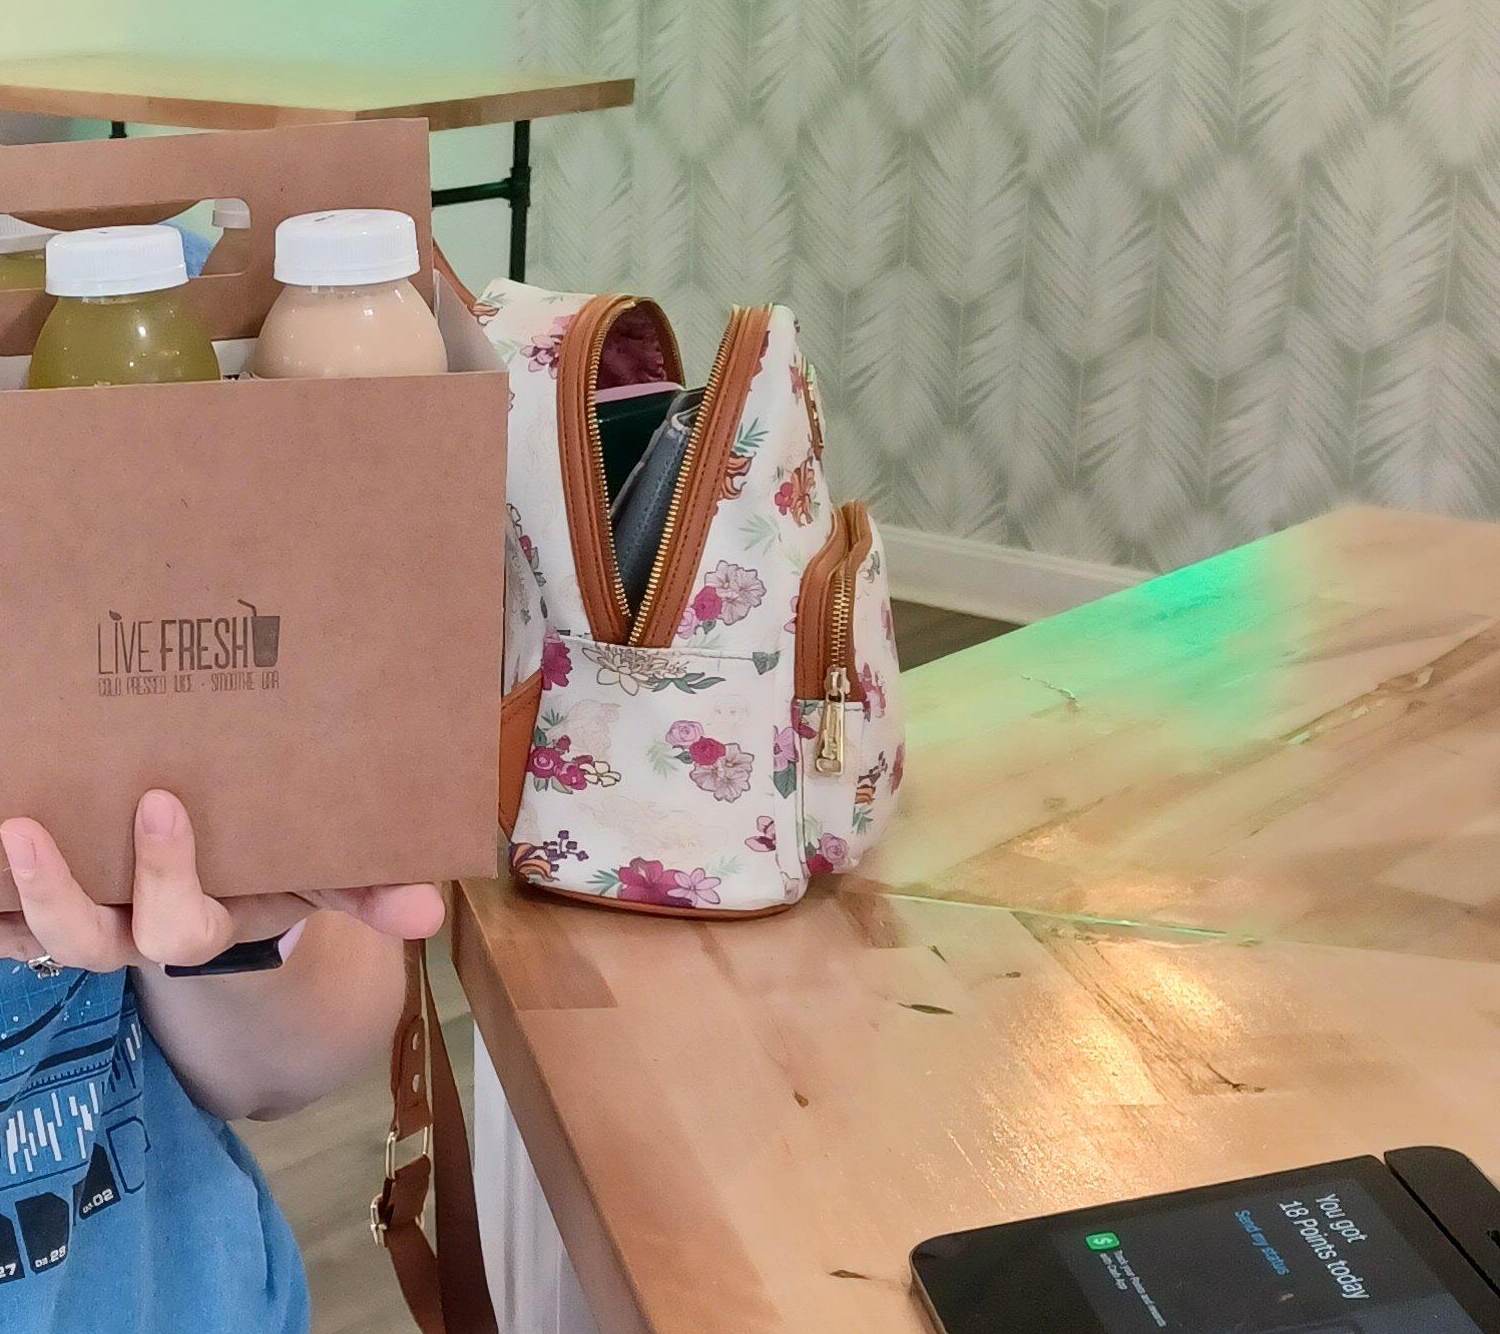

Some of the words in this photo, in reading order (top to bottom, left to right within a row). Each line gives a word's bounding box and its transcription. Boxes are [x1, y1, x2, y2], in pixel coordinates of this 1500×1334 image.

[97, 615, 153, 675] LIVE
[160, 617, 248, 672] FRESH
[1279, 1200, 1309, 1218] 18
[1315, 1193, 1346, 1219] You
[1293, 1218, 1338, 1260] Points
[1329, 1219, 1368, 1243] got
[1327, 1260, 1370, 1299] today
